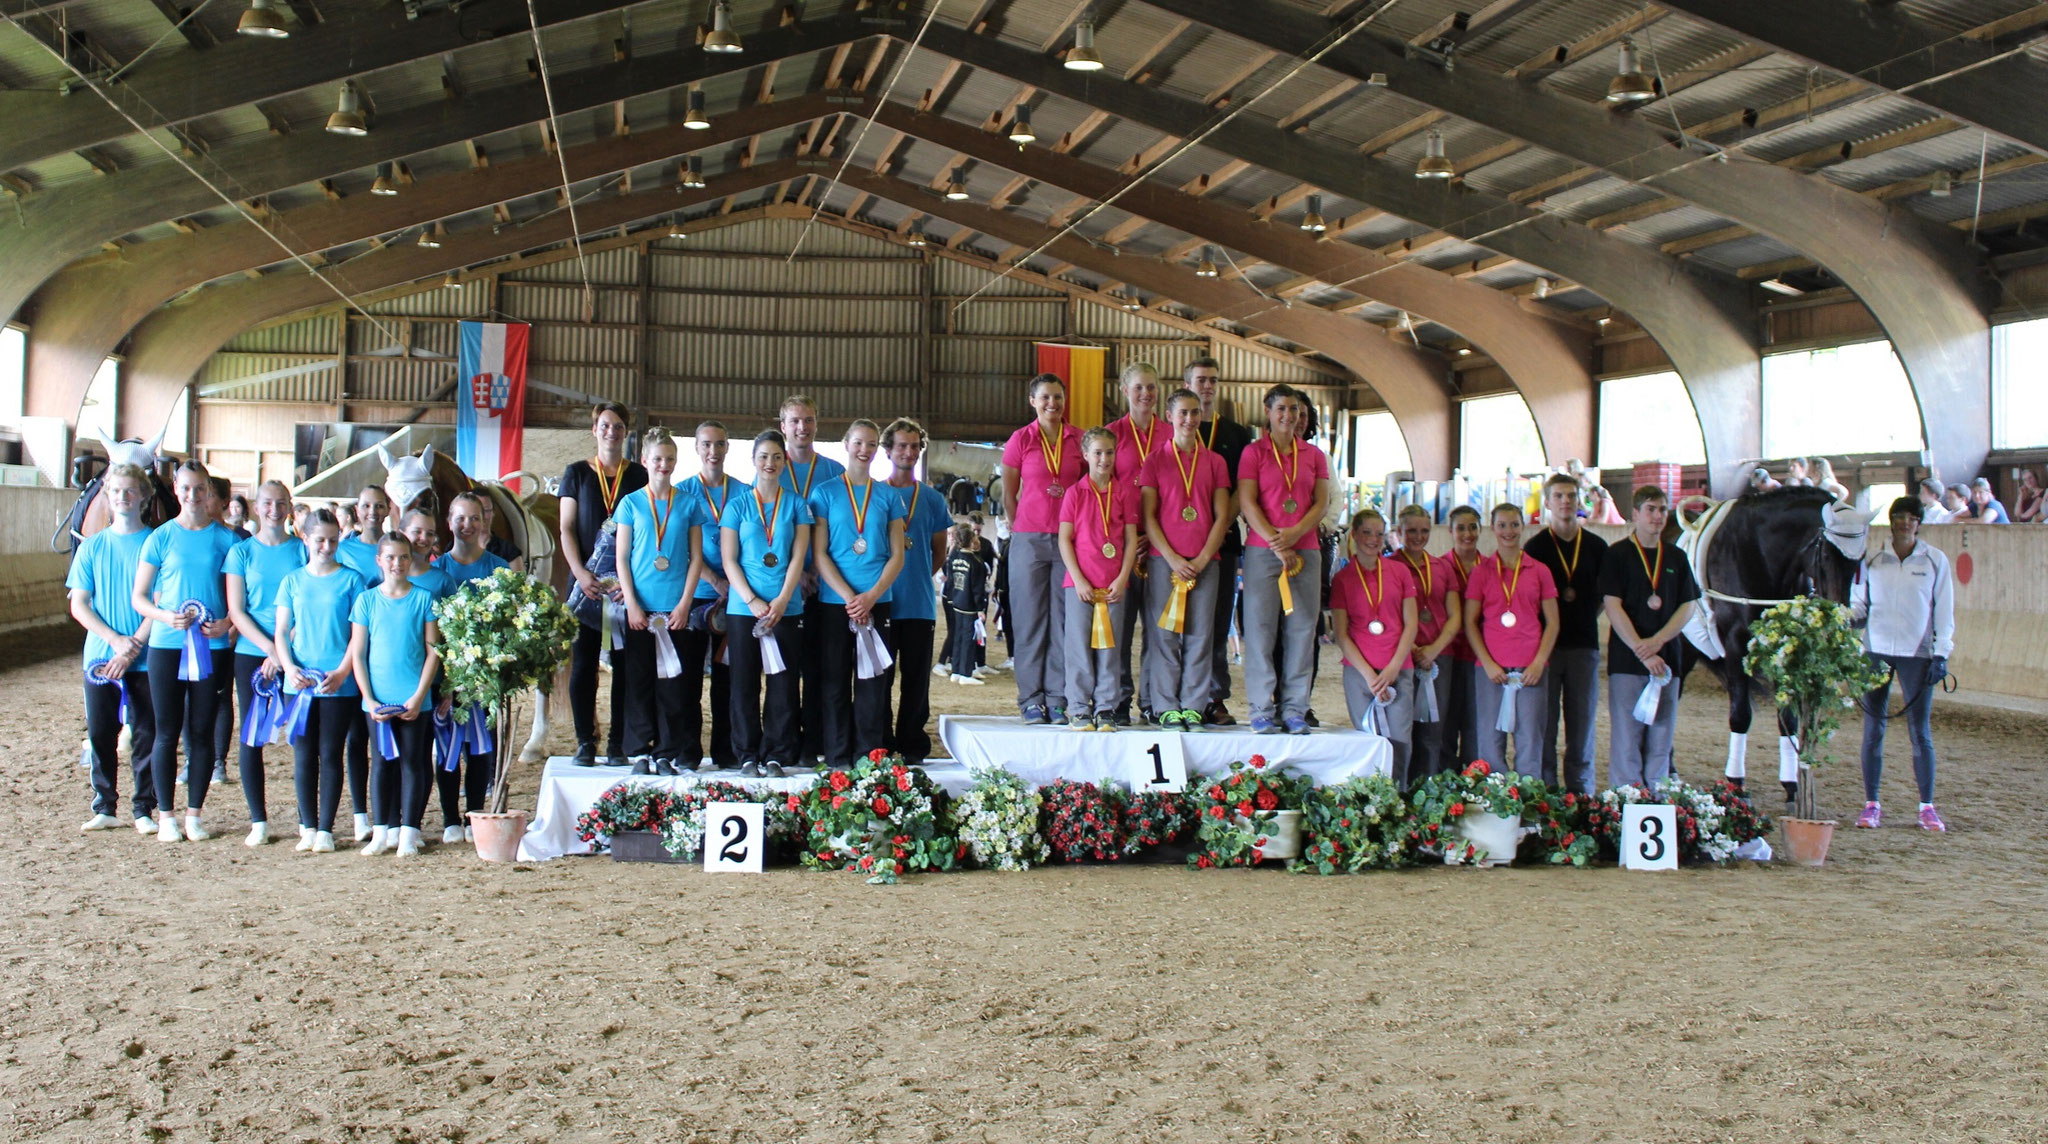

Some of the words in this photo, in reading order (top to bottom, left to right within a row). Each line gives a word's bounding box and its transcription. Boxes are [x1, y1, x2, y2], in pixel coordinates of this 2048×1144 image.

[1961, 529, 1969, 547] E
[1147, 743, 1170, 784] 1
[719, 815, 748, 863] 2
[1639, 815, 1665, 861] 3
